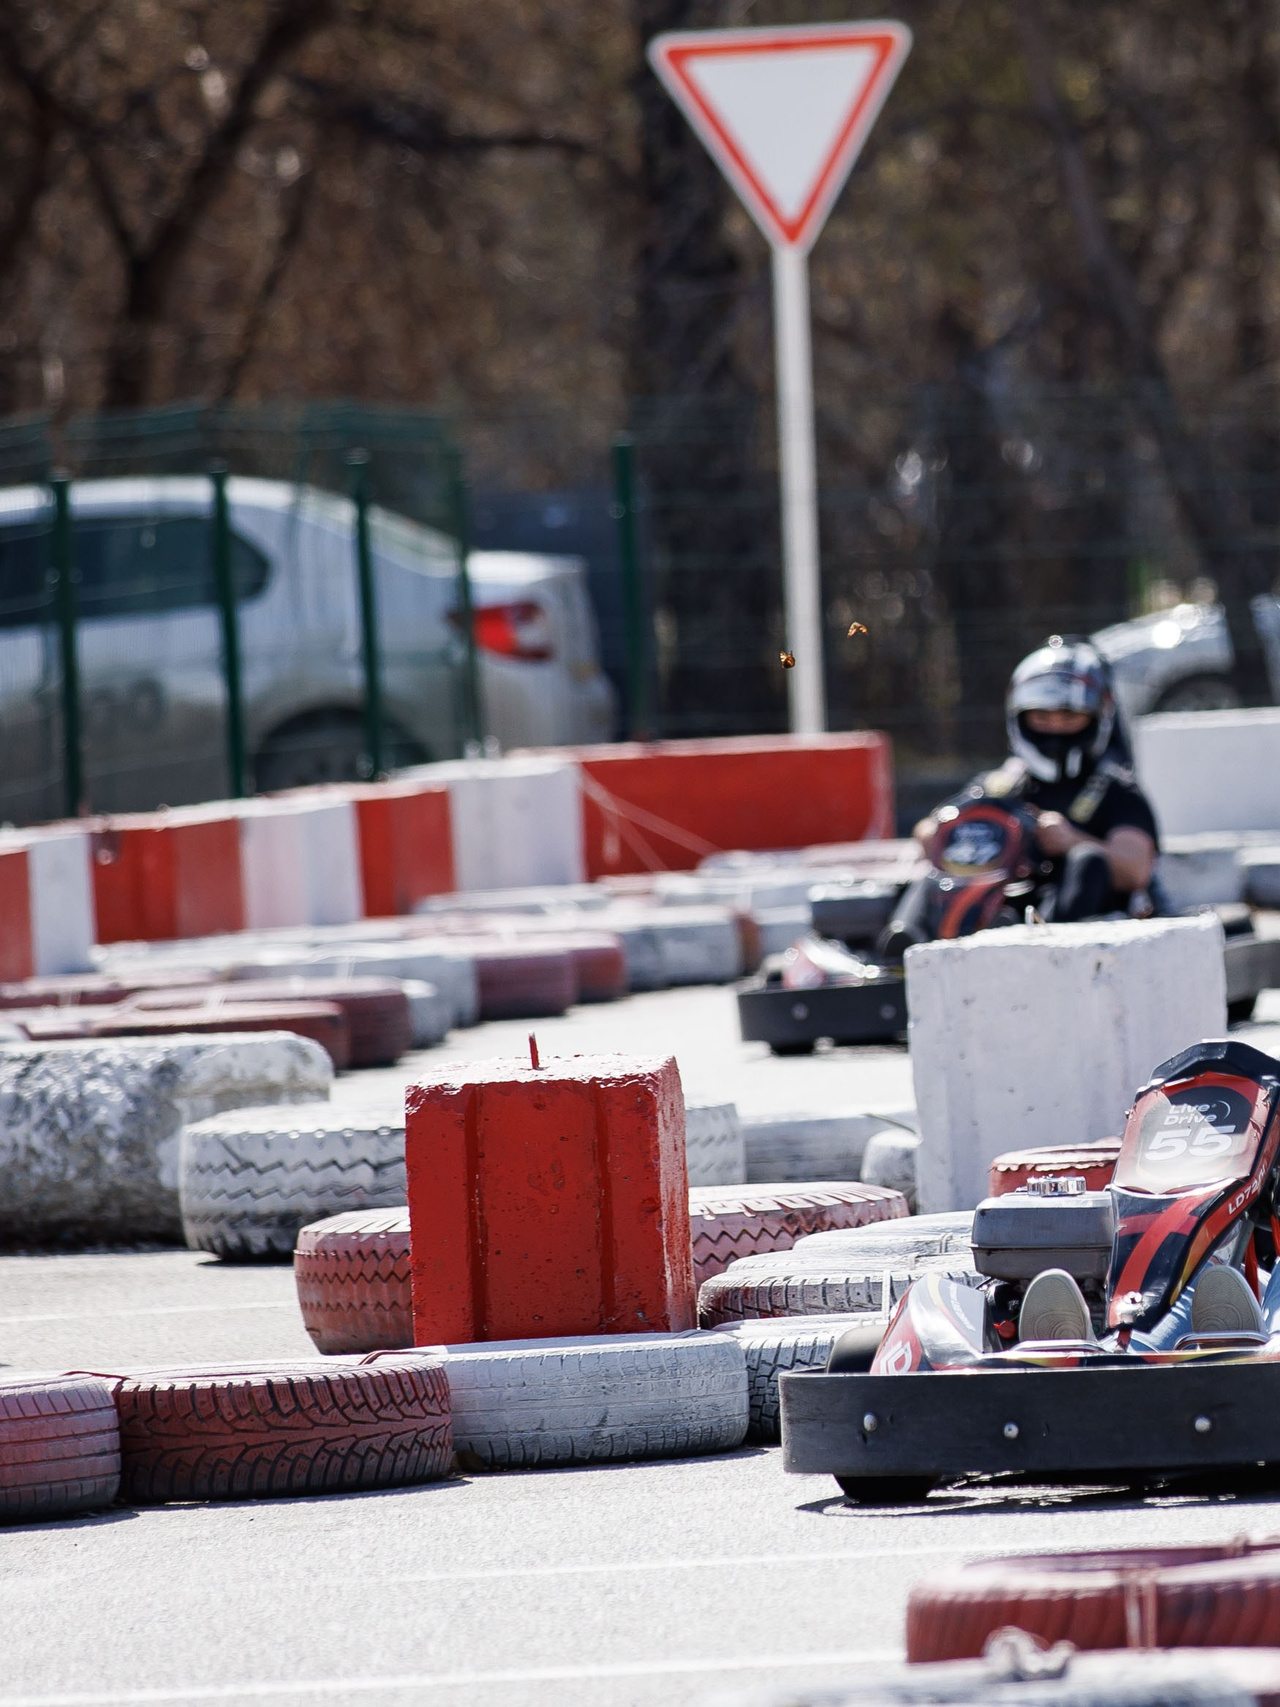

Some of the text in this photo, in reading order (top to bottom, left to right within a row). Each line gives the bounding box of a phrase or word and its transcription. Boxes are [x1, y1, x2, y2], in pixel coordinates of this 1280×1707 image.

[1169, 1103, 1210, 1115] Live
[1163, 1113, 1217, 1126] Drive
[1145, 1124, 1236, 1161] 55
